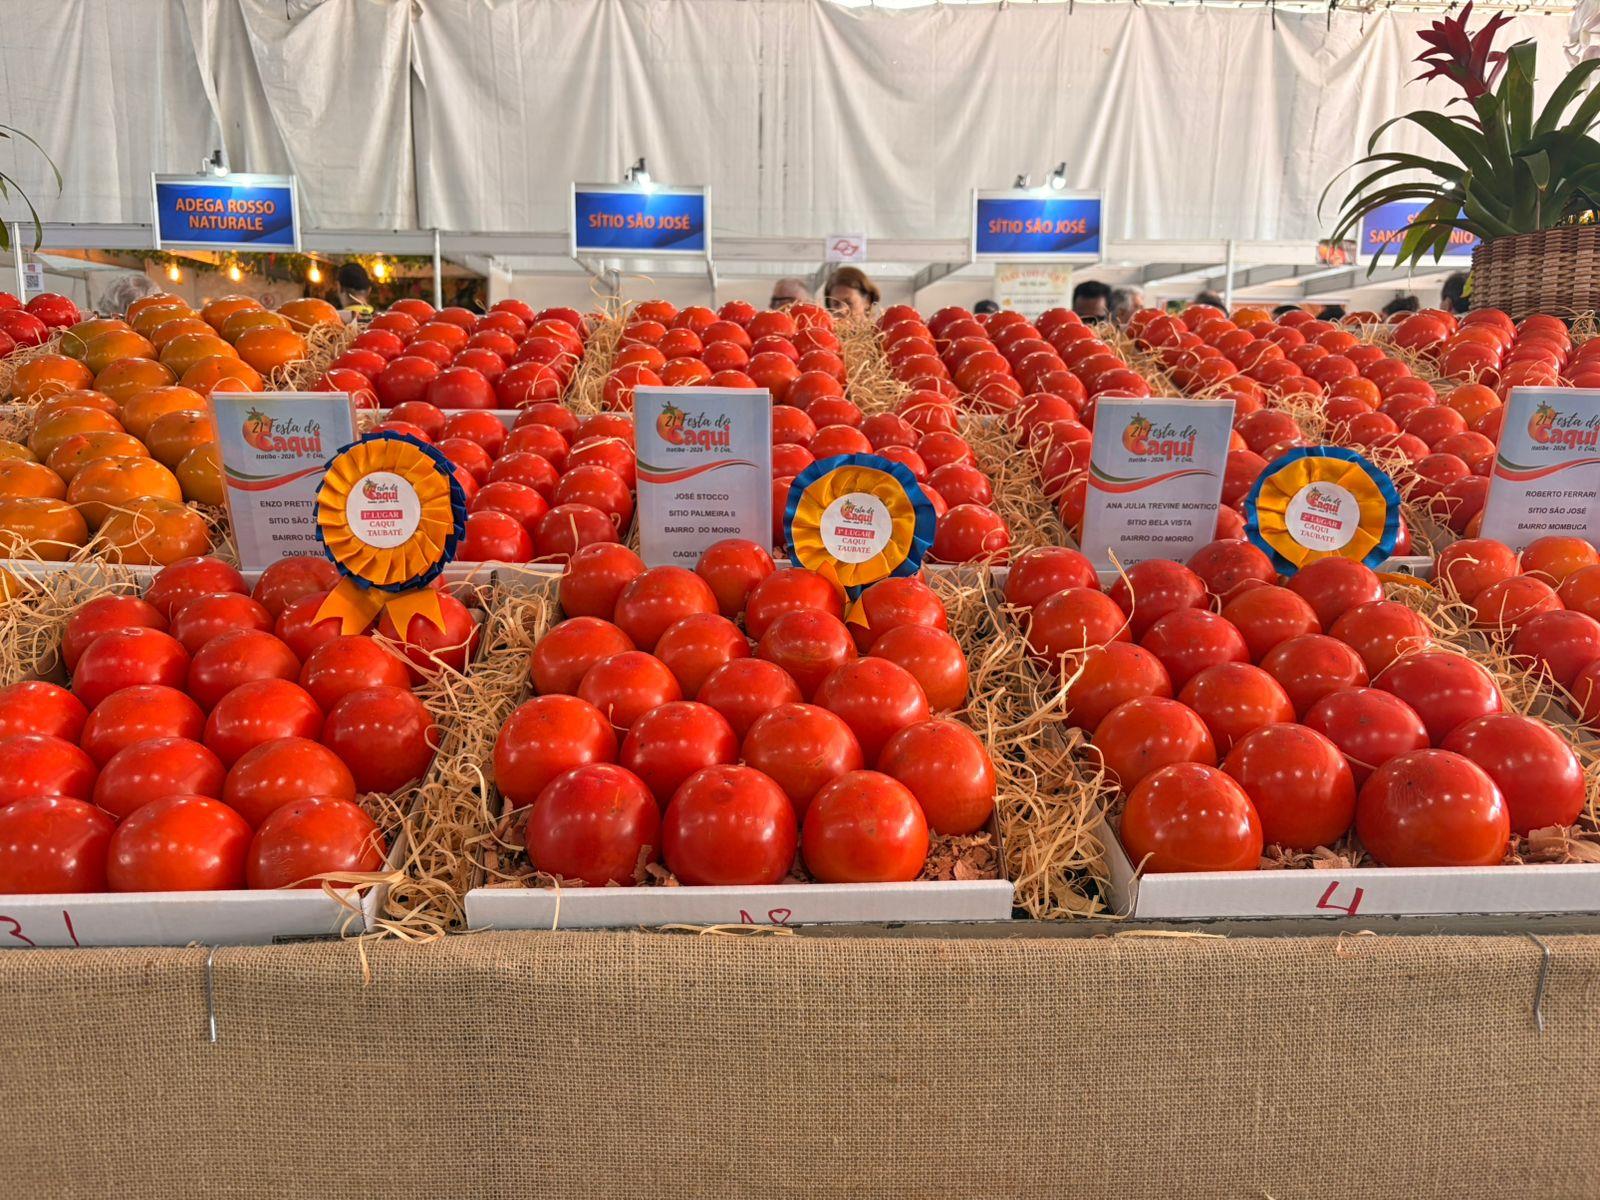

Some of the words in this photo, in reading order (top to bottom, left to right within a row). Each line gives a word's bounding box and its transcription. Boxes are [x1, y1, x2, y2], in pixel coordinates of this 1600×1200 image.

[176, 198, 224, 213] ADEGA
[228, 199, 275, 214] ROSSO
[189, 215, 264, 231] NATURALE
[589, 212, 624, 229] SÍTIO
[627, 212, 655, 229] SÃO
[658, 214, 690, 230] JOSÉ
[988, 218, 1022, 234] SÍTIO
[1026, 217, 1053, 234] SÃO
[1055, 217, 1087, 234] JOSÉ
[681, 412, 711, 428] Festa
[715, 413, 731, 427] do
[1551, 411, 1582, 428] Festa
[269, 418, 301, 435] Festa
[304, 419, 320, 434] do
[1147, 422, 1176, 439] Festa
[1180, 425, 1198, 439] do
[668, 424, 730, 451] Caqui
[1536, 424, 1600, 449] Caqui
[256, 431, 321, 457] Caqui
[1132, 434, 1195, 461] Caqui
[674, 492, 695, 500] JOSÉ
[697, 493, 729, 501] STOCCO
[1525, 490, 1562, 498] ROBERTO
[1563, 490, 1597, 498] FERRARI
[260, 500, 282, 508] ENZO
[284, 500, 313, 508] PRETTI
[1549, 506, 1565, 514] SÃO
[1566, 506, 1587, 515] JOSÉ
[269, 517, 289, 525] SITIO
[291, 516, 308, 524] SÃO
[371, 511, 399, 519] LUGAR
[1310, 515, 1338, 528] LUGAR
[367, 528, 404, 537] TAUBATÉ
[844, 528, 872, 538] LUGAR
[1304, 522, 1329, 534] CAQUI
[842, 537, 867, 545] CAQUI
[1120, 534, 1150, 542] BAIRRO
[673, 550, 697, 558] CAQUI
[837, 544, 872, 554] TAUBATÉ
[1316, 880, 1364, 916] 4
